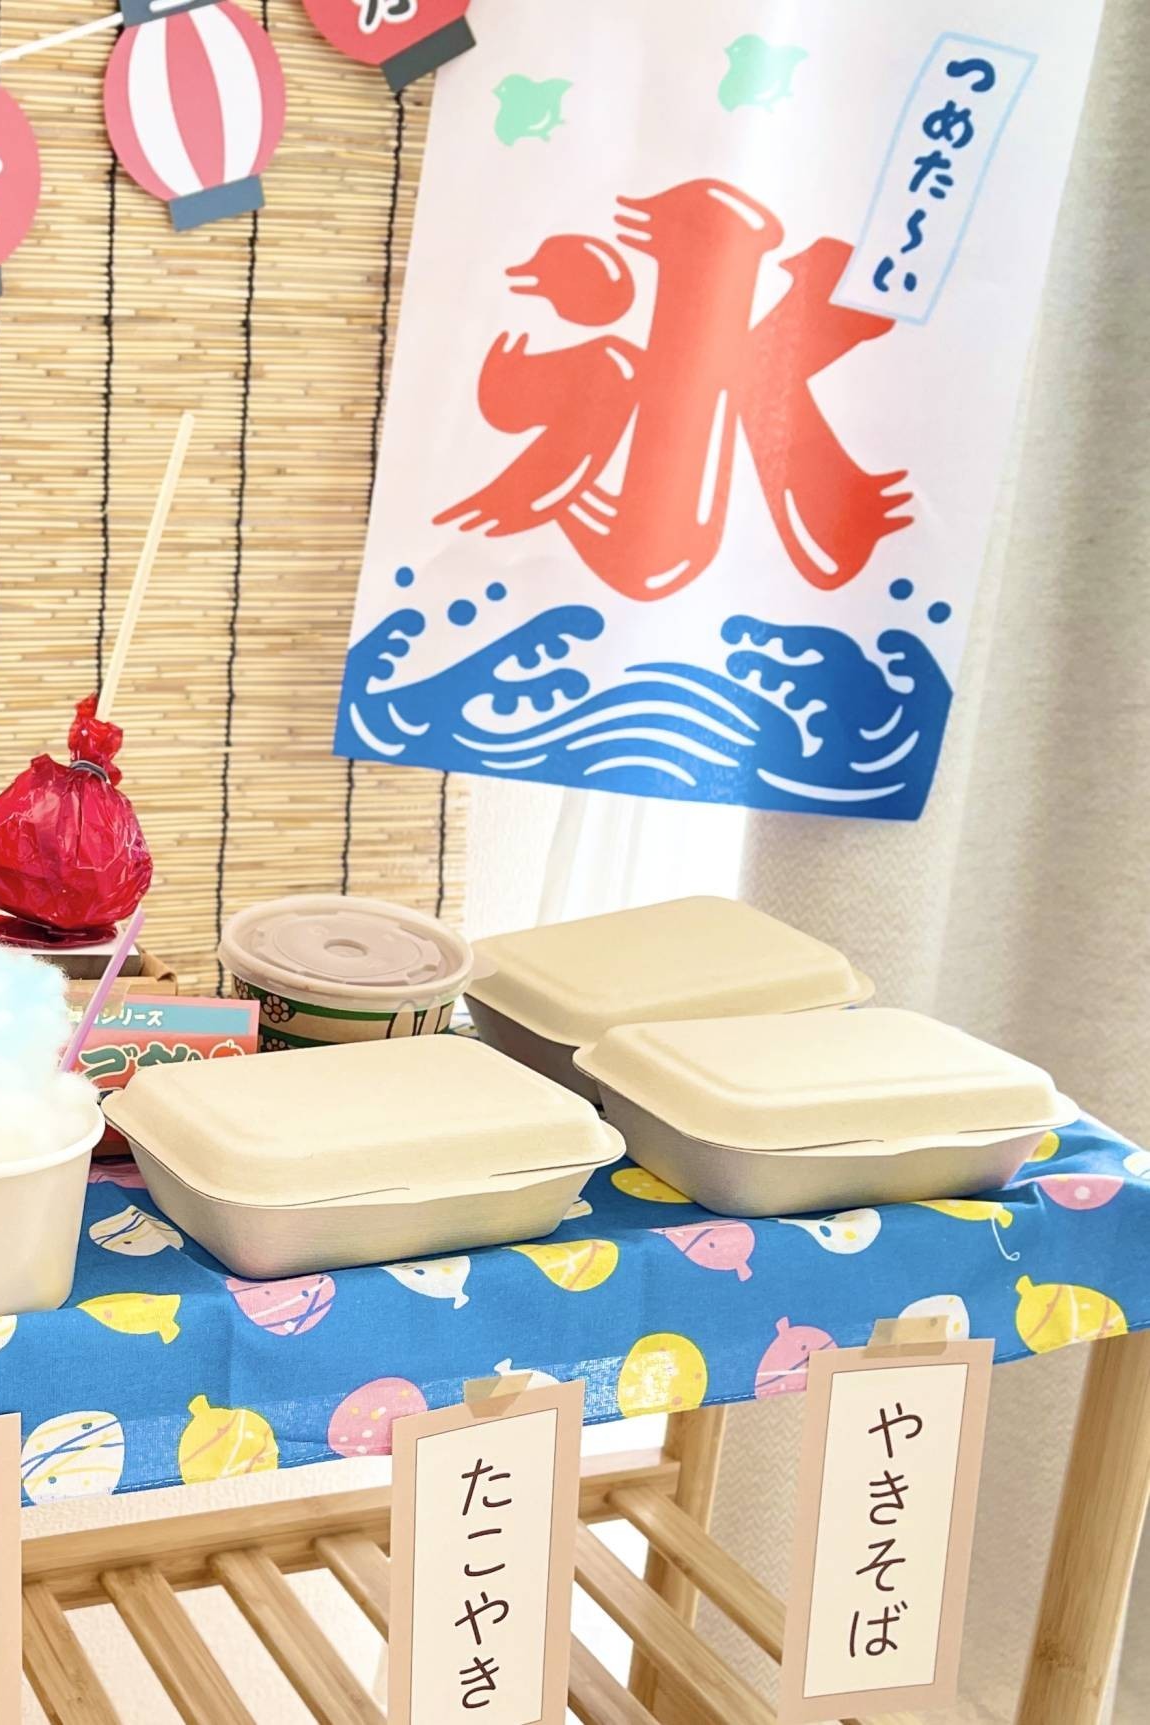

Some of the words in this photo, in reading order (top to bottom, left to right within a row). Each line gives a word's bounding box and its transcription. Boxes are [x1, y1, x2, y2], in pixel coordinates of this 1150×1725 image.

[431, 177, 915, 602] 氷
[454, 1458, 514, 1710] たこやき
[848, 1402, 923, 1659] やきそば
